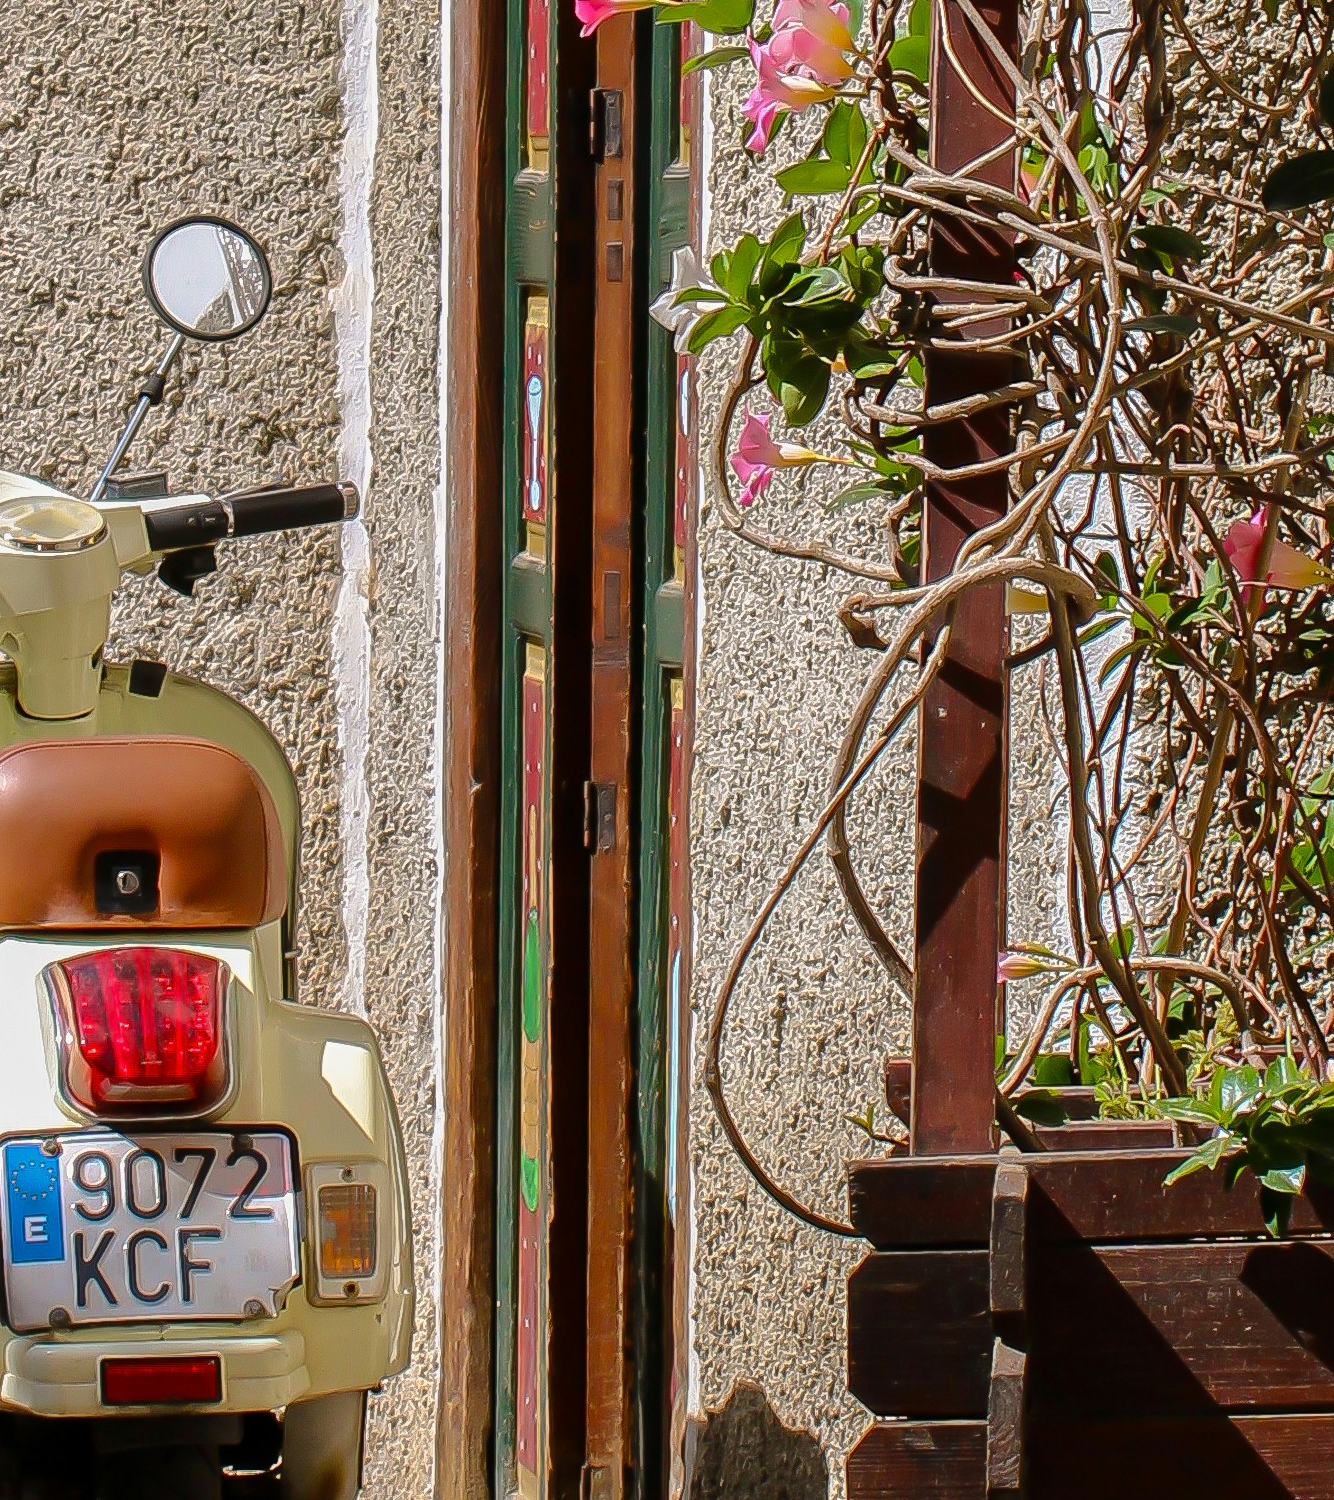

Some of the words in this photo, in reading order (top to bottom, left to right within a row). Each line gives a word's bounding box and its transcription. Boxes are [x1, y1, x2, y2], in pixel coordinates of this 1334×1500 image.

[70, 1148, 275, 1221] 9072
[24, 1215, 49, 1242] E
[71, 1226, 223, 1308] KCF
